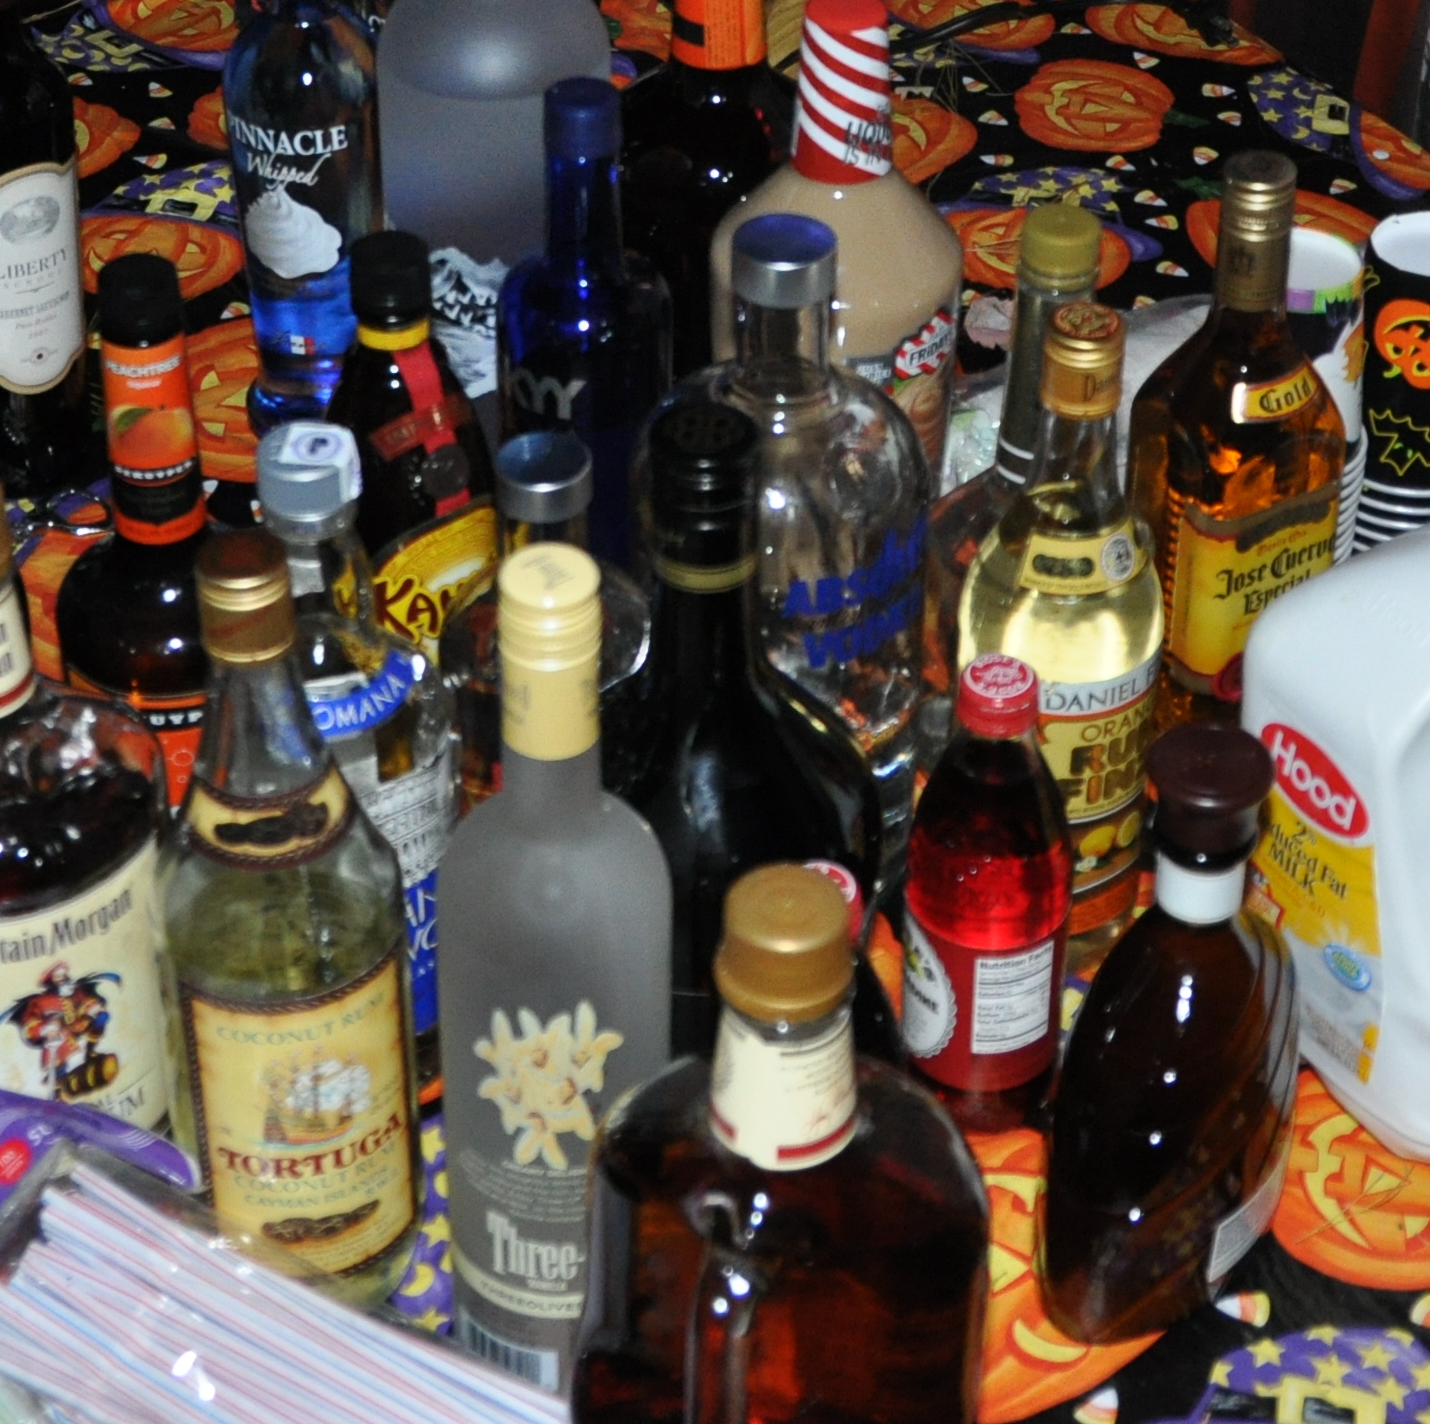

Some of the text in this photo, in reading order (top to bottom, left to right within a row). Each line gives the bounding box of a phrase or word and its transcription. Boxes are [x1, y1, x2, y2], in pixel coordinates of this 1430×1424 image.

[245, 149, 332, 194] Whipped
[1259, 375, 1313, 415] Gold
[1211, 566, 1269, 602] Jose
[311, 672, 407, 732] OMANA
[1044, 680, 1142, 712] DANIEL
[1272, 729, 1358, 832] Hood
[1268, 840, 1317, 896] MILK
[1321, 862, 1349, 899] Fat
[48, 888, 133, 958] Morgan
[218, 1112, 403, 1179] TORTUGA
